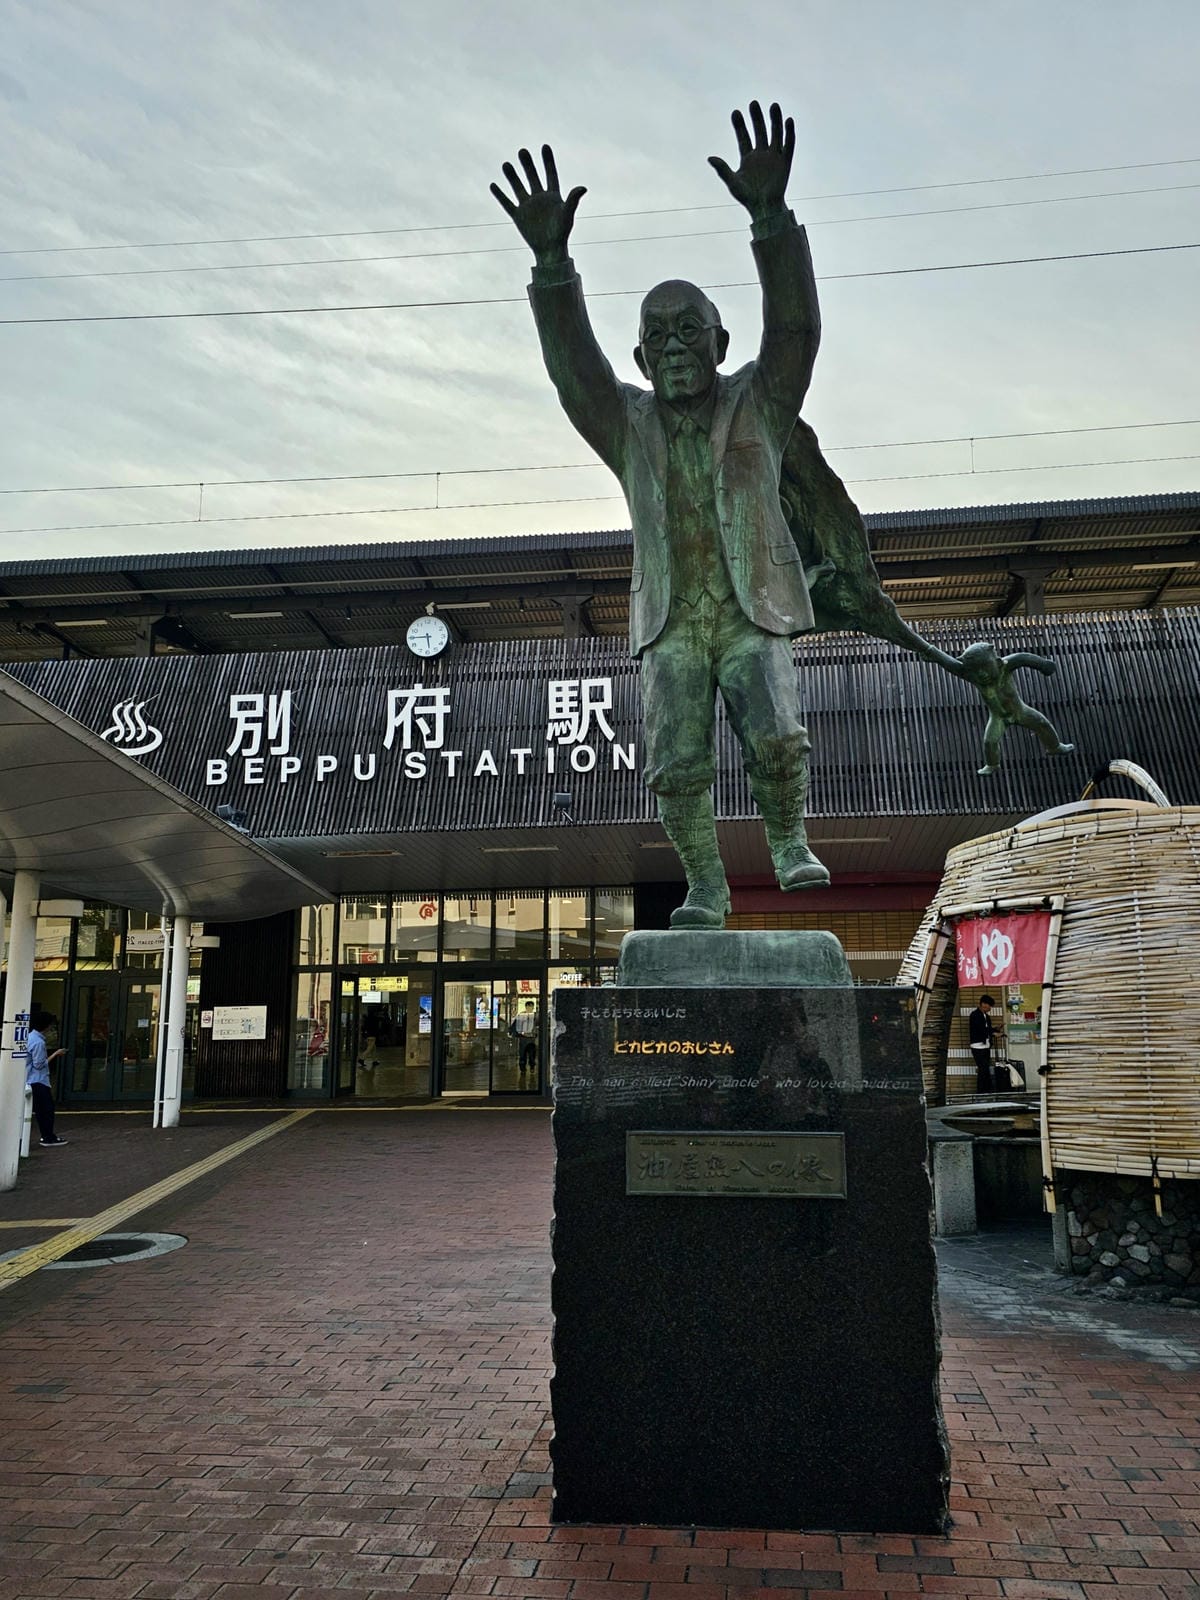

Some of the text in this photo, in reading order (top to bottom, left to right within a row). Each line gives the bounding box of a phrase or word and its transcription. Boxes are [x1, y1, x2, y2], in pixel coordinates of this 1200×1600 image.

[226, 677, 616, 757] 別府駅
[206, 743, 635, 786] BEPPU STATION
[980, 928, 1014, 977] ゆ
[580, 1007, 687, 1019] 子どもたちをあいした
[614, 1040, 735, 1055] ピカピカのおじさん
[775, 1076, 801, 1089] who
[807, 1076, 847, 1089] loved
